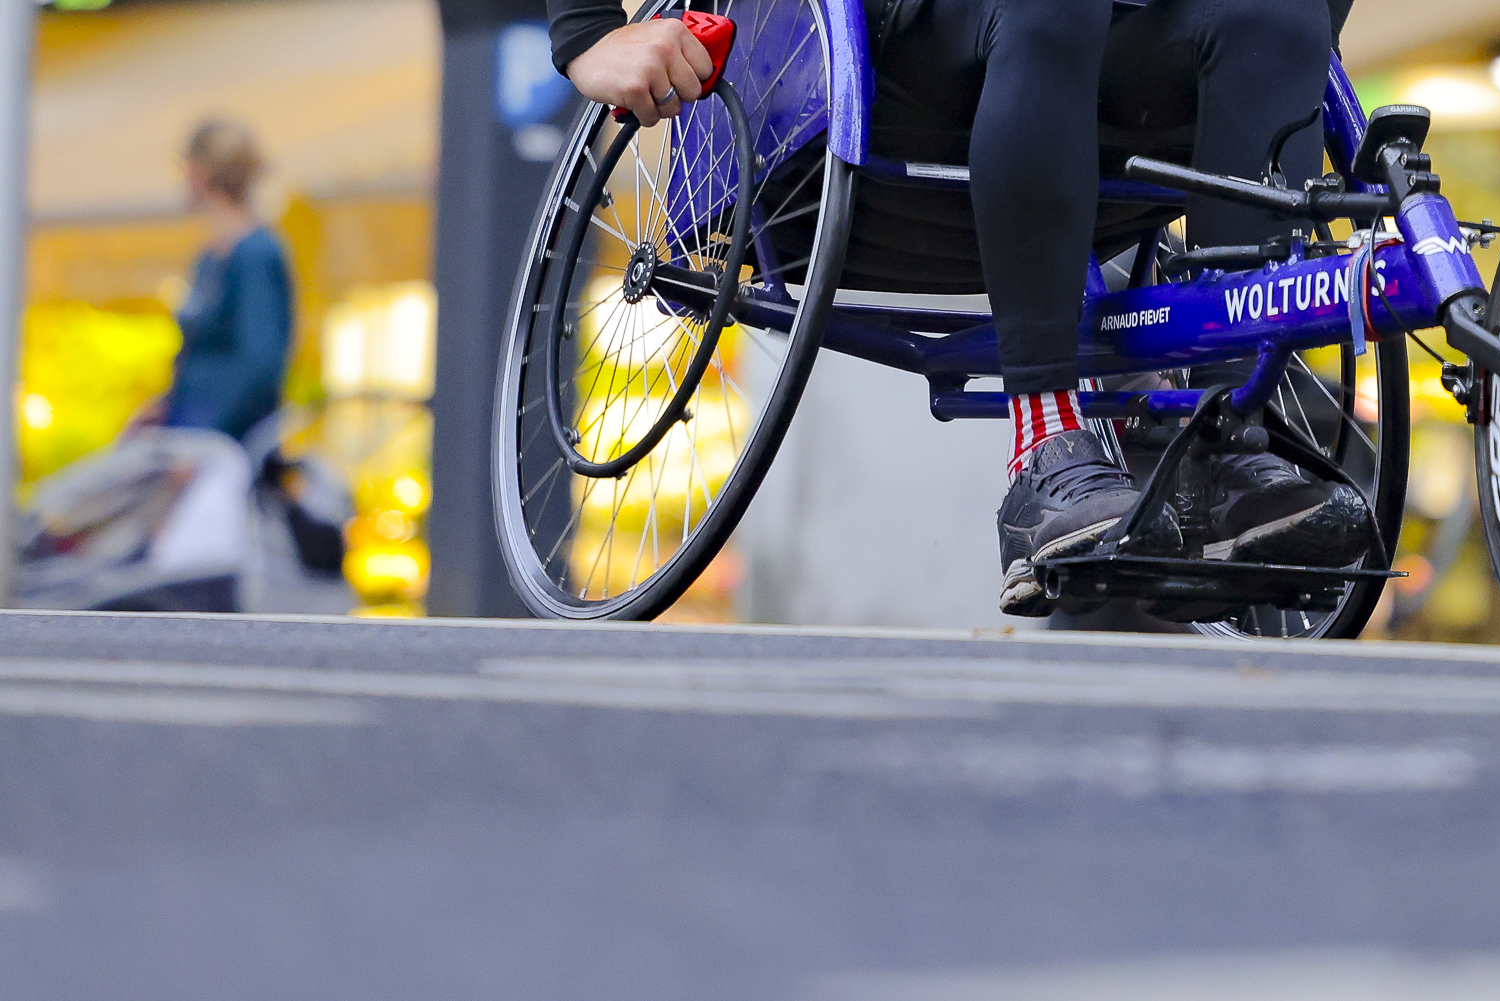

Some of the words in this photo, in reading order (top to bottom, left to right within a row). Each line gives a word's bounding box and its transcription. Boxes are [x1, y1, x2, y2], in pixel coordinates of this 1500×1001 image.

[1390, 105, 1420, 113] GARMIN
[1224, 259, 1387, 324] WOLTURNS
[1101, 311, 1139, 331] ARNAUD
[1139, 306, 1171, 326] FIEVET
